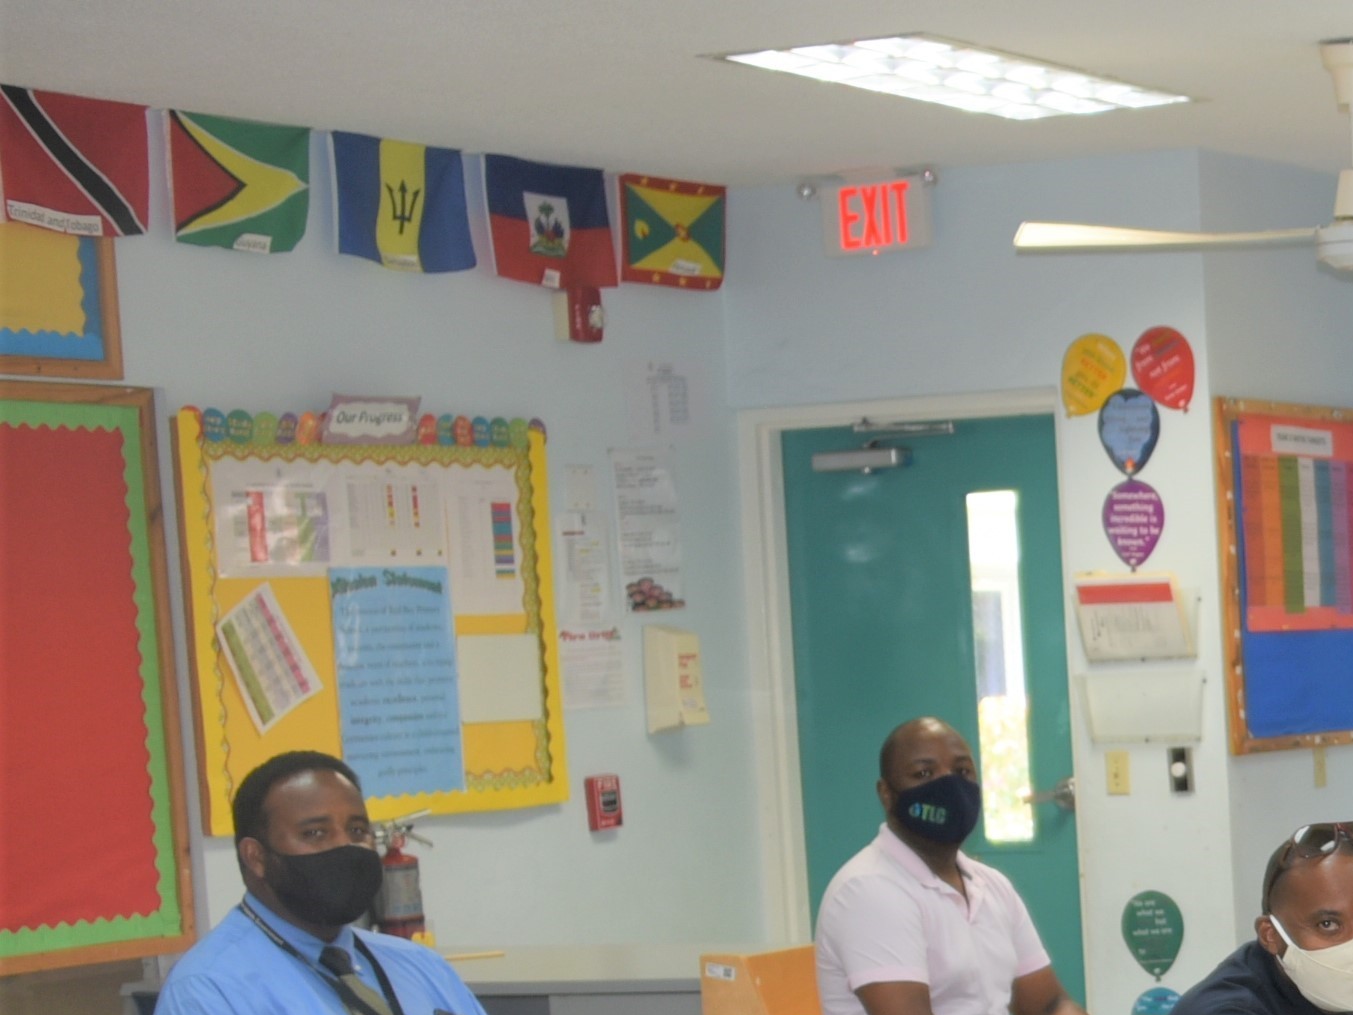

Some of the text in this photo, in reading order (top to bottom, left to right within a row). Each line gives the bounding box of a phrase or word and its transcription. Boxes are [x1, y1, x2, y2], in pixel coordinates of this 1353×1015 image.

[8, 203, 99, 233] Trinidad and Tobago
[839, 181, 908, 250] EXIT
[336, 410, 402, 426] Our Progress
